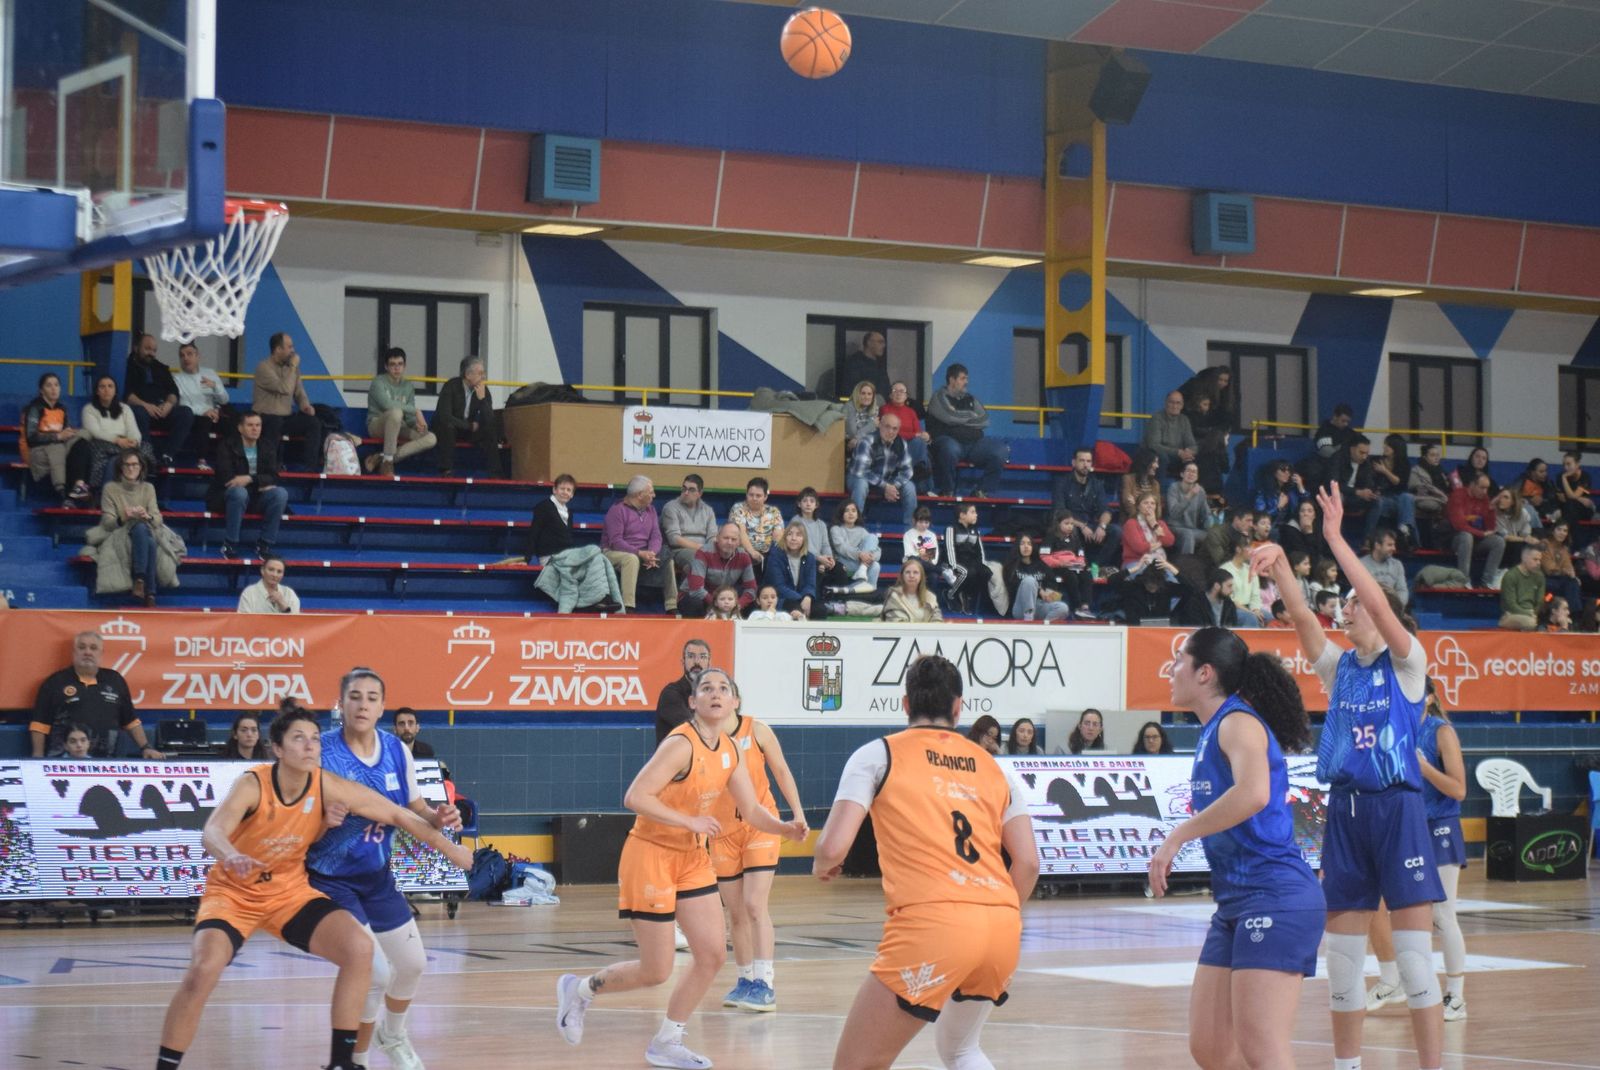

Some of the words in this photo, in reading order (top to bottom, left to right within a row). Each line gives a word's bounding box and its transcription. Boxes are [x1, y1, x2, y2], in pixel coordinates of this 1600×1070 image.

[660, 425, 766, 442] AYUNTAMIENTO
[659, 443, 681, 460] DE
[686, 445, 765, 463] ZAMORA
[1484, 651, 1575, 676] recoletas
[162, 673, 314, 705] ZAMORA
[509, 676, 649, 706] ZAMORA
[1352, 725, 1377, 750] 25
[363, 824, 386, 844] 15
[951, 810, 981, 865] 8
[57, 845, 217, 861] TIERR
